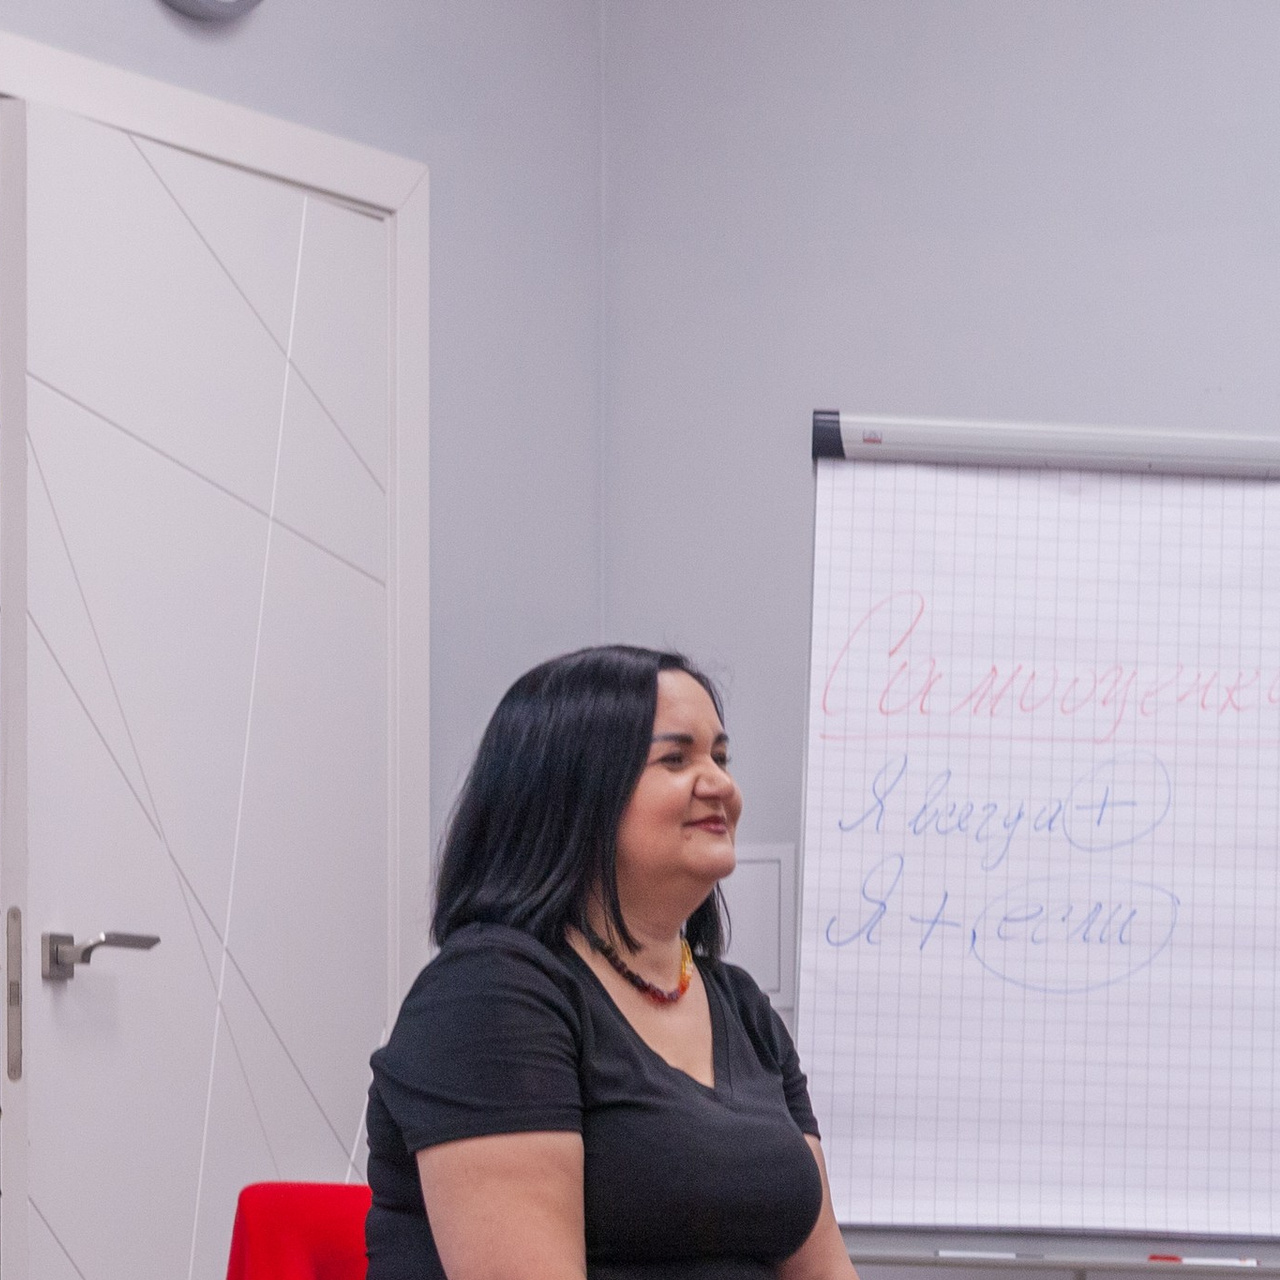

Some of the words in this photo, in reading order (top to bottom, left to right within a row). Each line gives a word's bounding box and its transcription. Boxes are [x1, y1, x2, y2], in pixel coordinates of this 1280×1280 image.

[838, 753, 908, 834] Я
[908, 769, 1064, 871] всегда
[826, 853, 904, 946] Я
